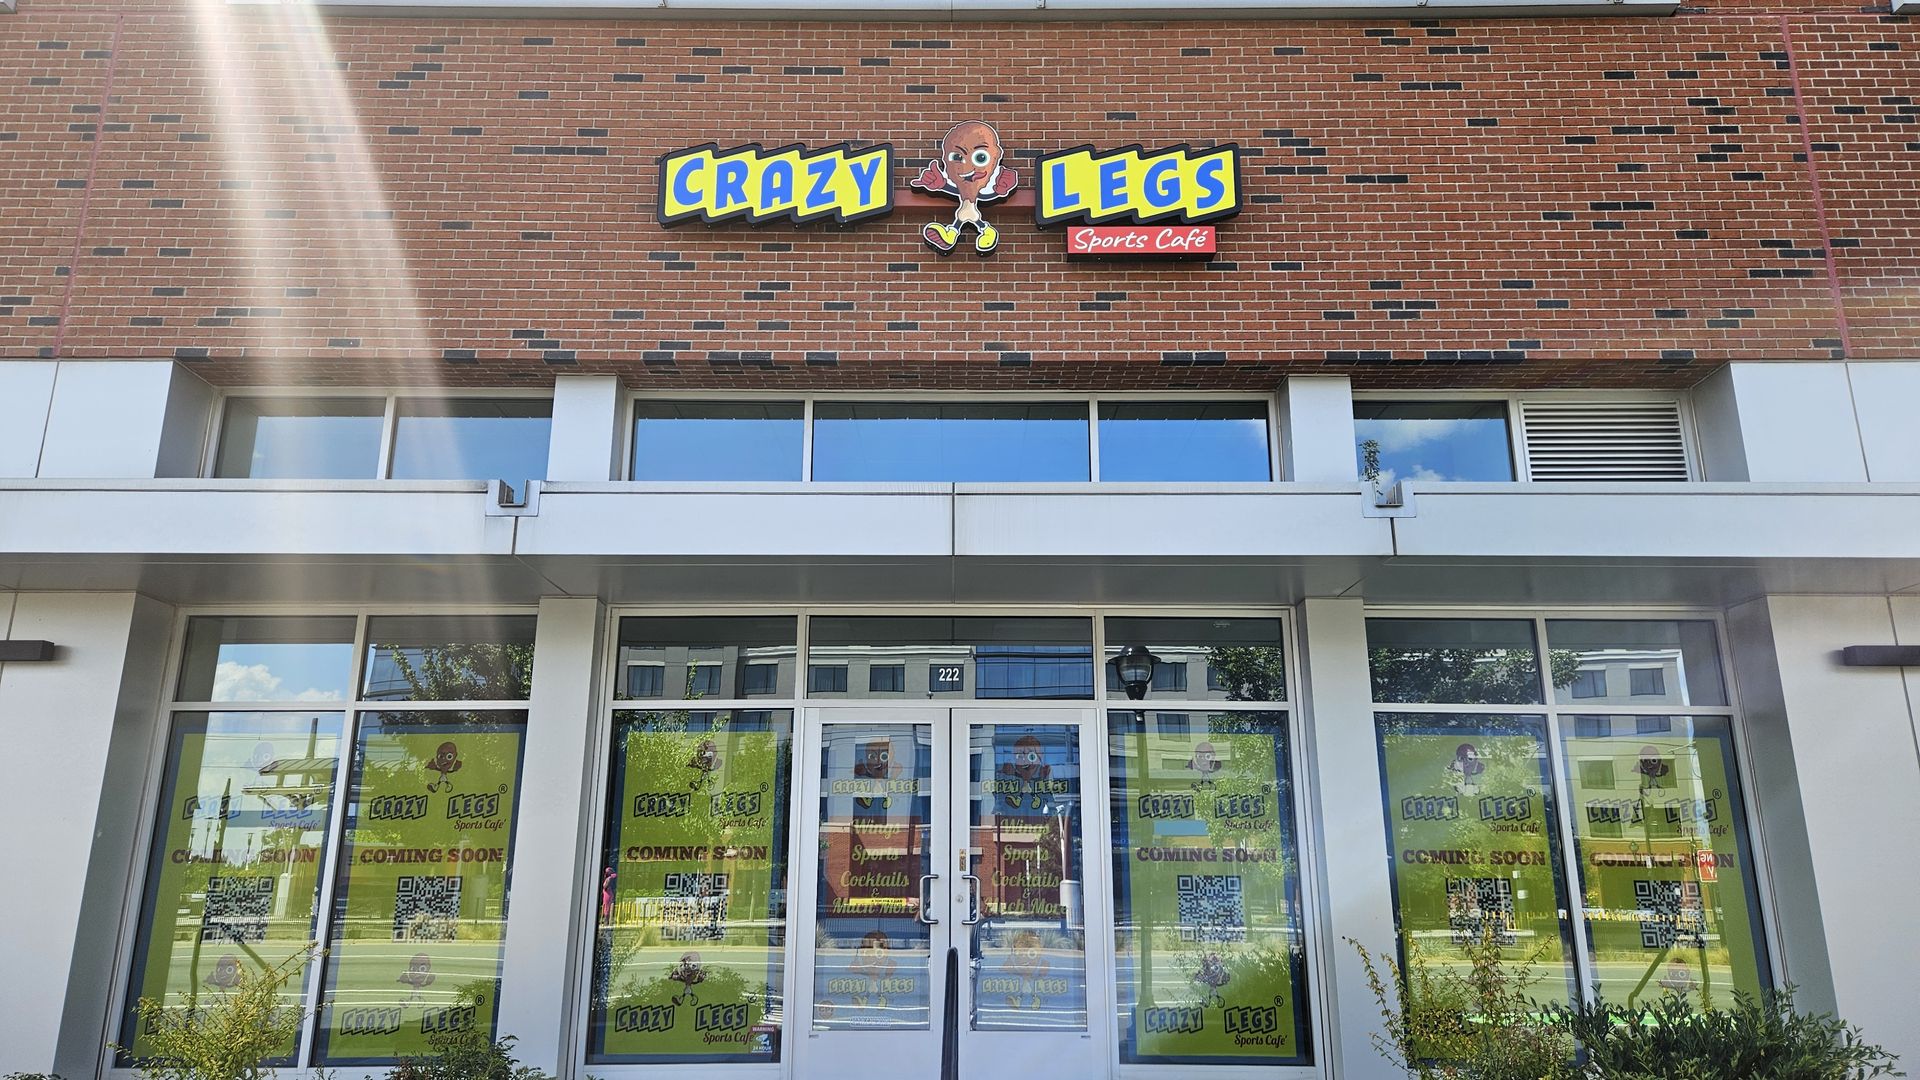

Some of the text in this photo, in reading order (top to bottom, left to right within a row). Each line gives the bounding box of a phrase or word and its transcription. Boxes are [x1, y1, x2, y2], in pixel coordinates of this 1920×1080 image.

[673, 156, 1225, 210] CRAZY LEGS
[1074, 228, 1208, 252] Sports Café
[939, 668, 959, 681] 222
[833, 781, 918, 792] CRAZY LEGS
[983, 781, 1067, 792] CRAZY LEGS
[372, 797, 425, 816] CRAZY
[451, 797, 496, 816] LEGS
[637, 797, 687, 814] CRAZY
[1141, 799, 1193, 814] CRAZY
[1218, 798, 1261, 814] LEGS
[1405, 799, 1457, 817] CRAZY
[1483, 799, 1527, 817] LEGS
[454, 820, 482, 832] Sports
[853, 818, 901, 839] Wings
[1000, 818, 1050, 841] Wings
[1490, 822, 1519, 834] Sports
[360, 848, 504, 864] COMING SOON
[626, 846, 707, 861] COMING
[851, 844, 899, 865] Sports
[1003, 844, 1050, 864] Sports
[1136, 847, 1217, 862] COMING
[1403, 849, 1546, 865] COMING SOON
[840, 870, 910, 888] Cocktails
[991, 870, 1060, 888] Cocktails
[871, 887, 880, 898] &
[1022, 887, 1031, 898] &
[829, 979, 914, 992] CRAZY LEGS
[983, 979, 1067, 993] CRAZY LEGS
[344, 1011, 399, 1031] CRAZY
[618, 1007, 745, 1028] CRAZY LEGS
[1147, 1010, 1200, 1030] CRAZY
[1228, 1010, 1274, 1029] LEGS
[703, 1032, 732, 1045] Sports
[1234, 1034, 1263, 1047] Sports
